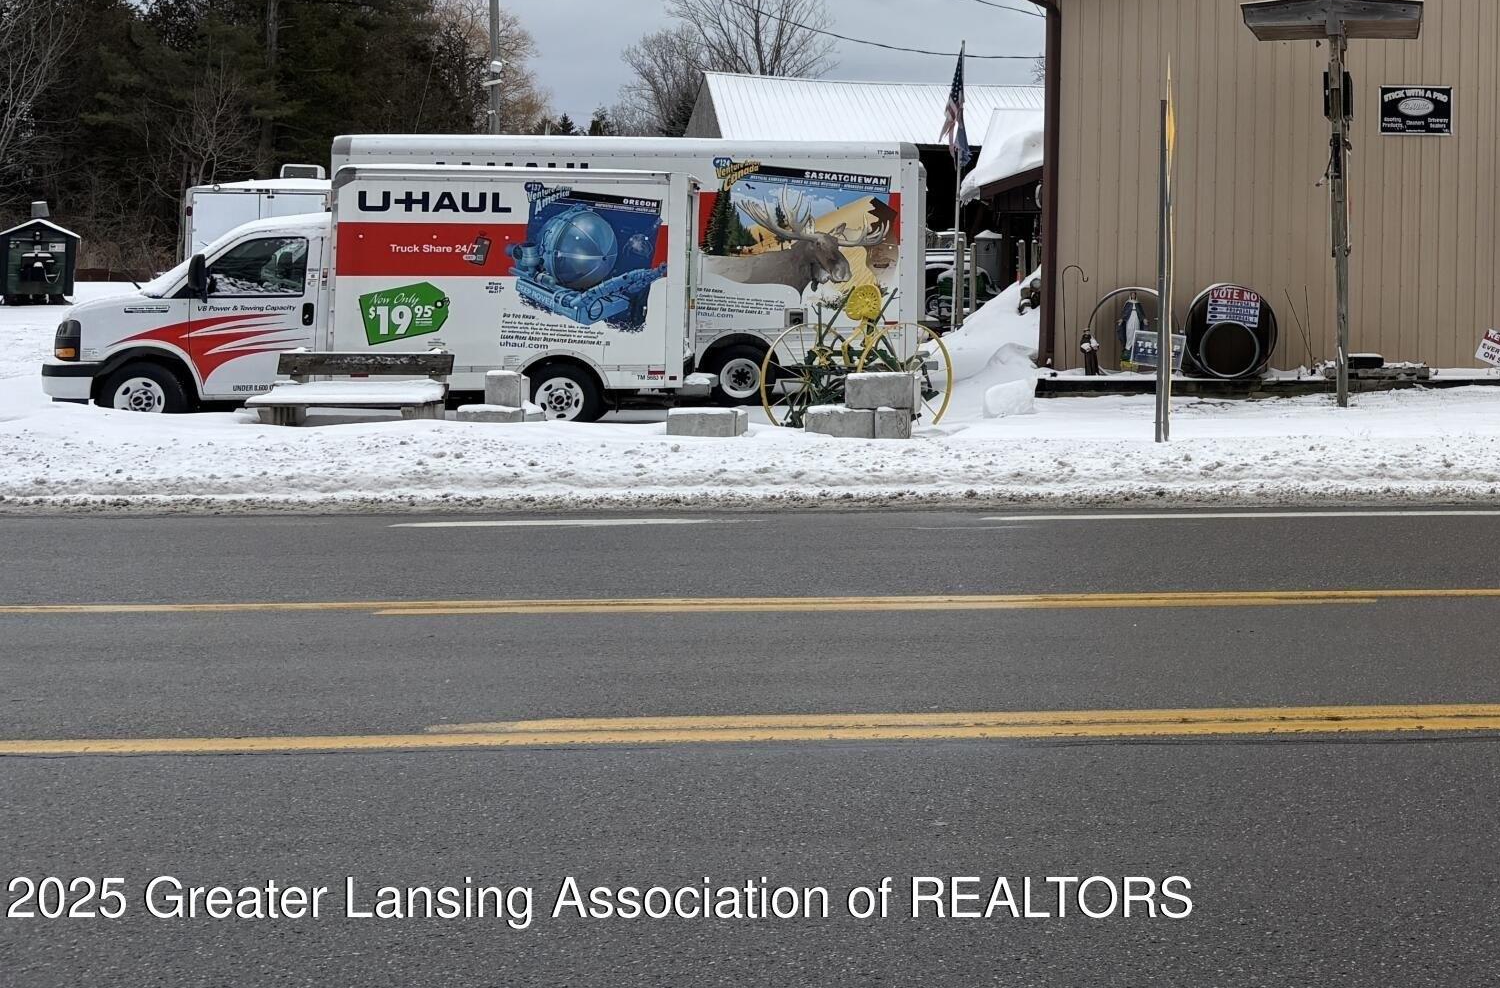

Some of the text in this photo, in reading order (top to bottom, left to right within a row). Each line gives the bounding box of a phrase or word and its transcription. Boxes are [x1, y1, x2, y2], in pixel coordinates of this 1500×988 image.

[804, 170, 887, 186] SASKATCHEWAN
[358, 190, 512, 214] U-HAUL
[390, 243, 420, 253] Truck
[422, 243, 452, 253] Share
[368, 292, 421, 307] Now Only
[1213, 288, 1258, 301] VOTE NO
[240, 305, 264, 313] Towing
[265, 304, 297, 313] Capacity
[499, 341, 549, 350] uhaul.com
[1137, 340, 1181, 352] TRP
[1483, 351, 1496, 360] ON
